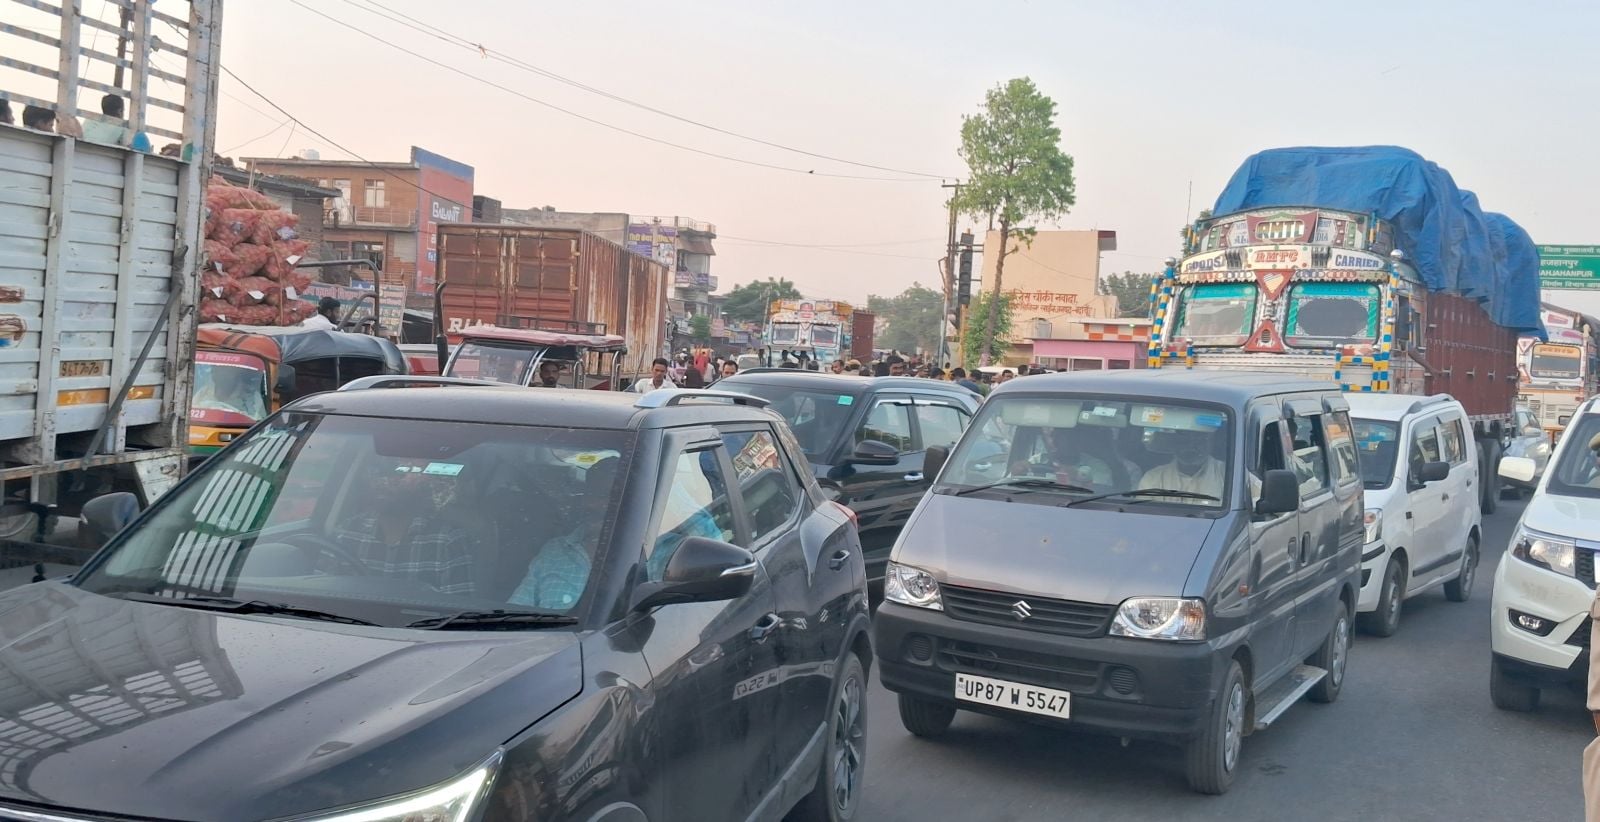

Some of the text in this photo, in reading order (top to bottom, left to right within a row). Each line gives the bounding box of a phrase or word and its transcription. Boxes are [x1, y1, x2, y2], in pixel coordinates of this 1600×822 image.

[1257, 221, 1306, 240] RMTC
[1255, 251, 1298, 263] RMTC
[1335, 254, 1379, 268] CARRIER
[1186, 258, 1224, 271] GOODS
[1540, 259, 1579, 269] हजहानपुर
[966, 680, 1067, 713] UP87 W 5547
